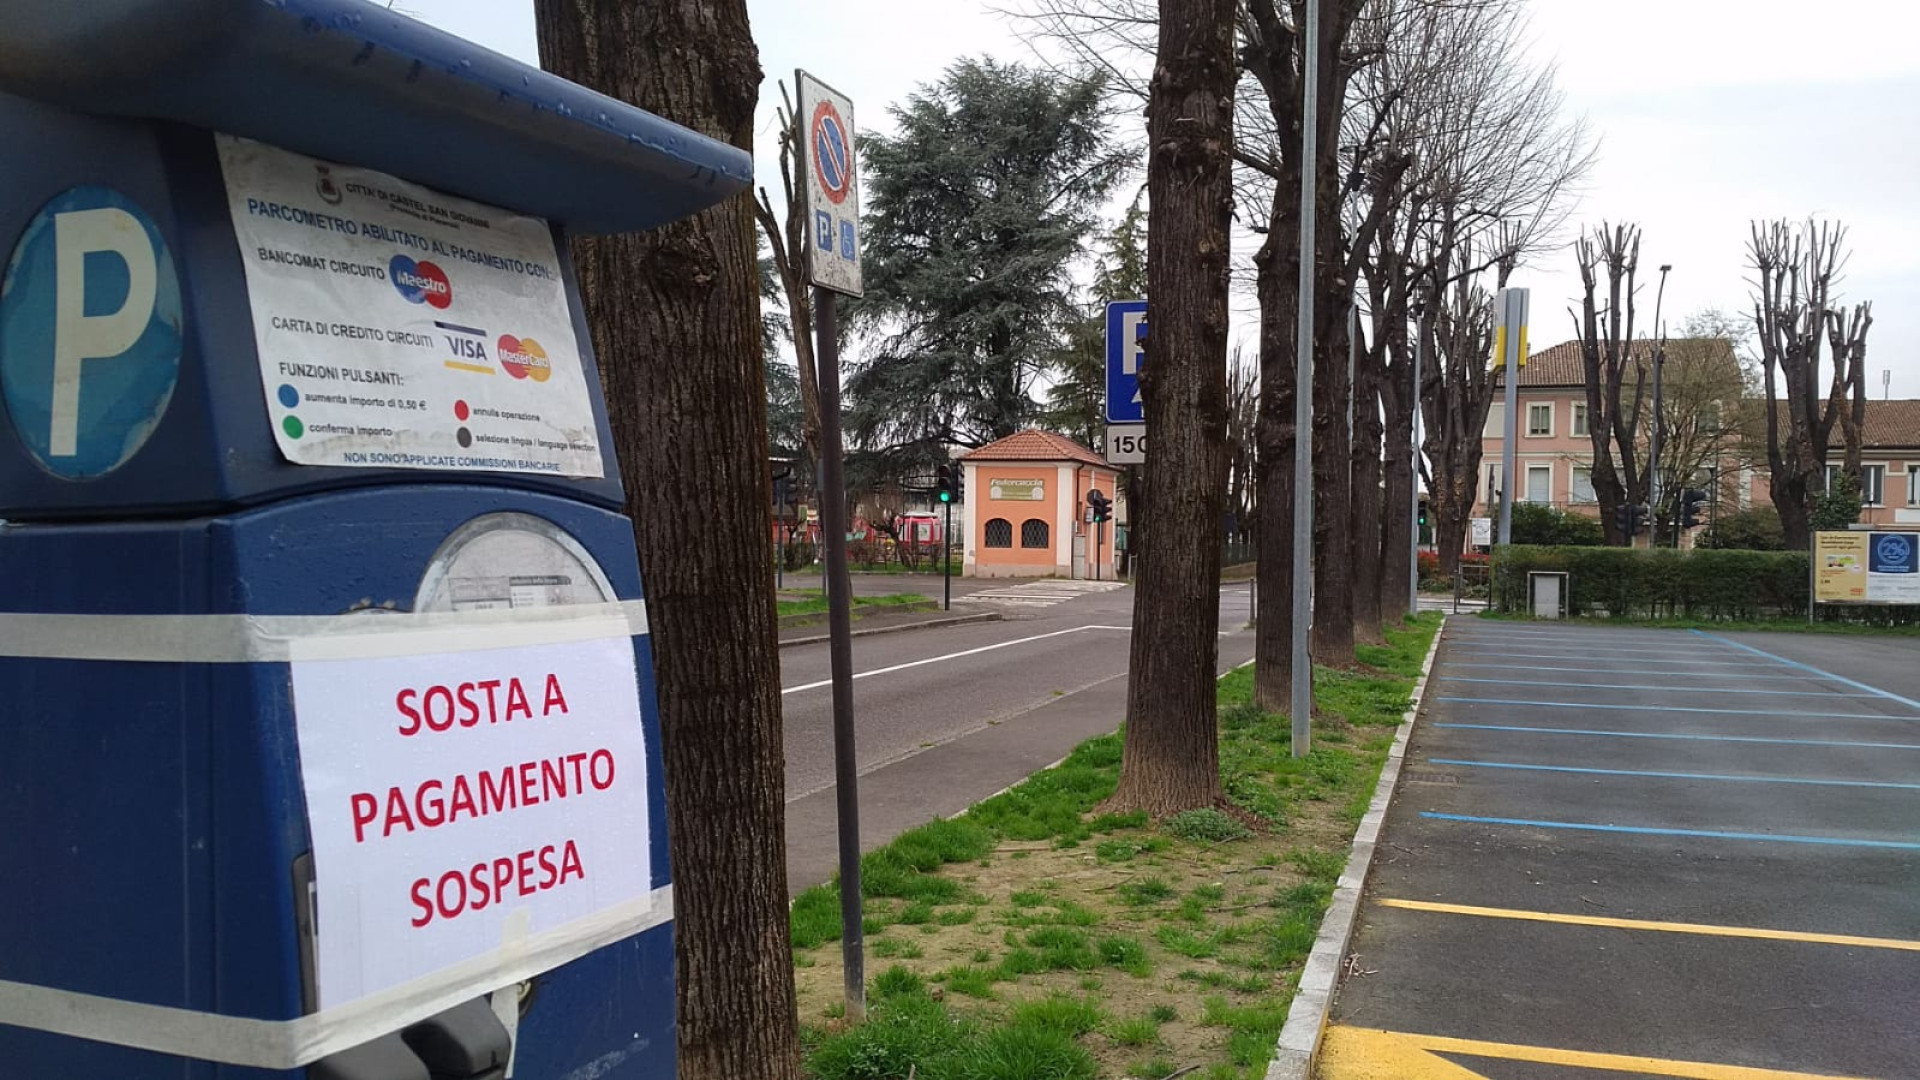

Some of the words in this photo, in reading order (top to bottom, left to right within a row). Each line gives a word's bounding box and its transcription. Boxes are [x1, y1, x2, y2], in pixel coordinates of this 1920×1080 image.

[390, 192, 426, 212] CASTEL
[428, 204, 448, 218] SAN
[247, 198, 357, 235] PARCOMETRO
[361, 222, 429, 251] ABILITATO
[432, 241, 449, 257] AL
[451, 246, 524, 273] PAGAMENTO
[819, 217, 829, 246] P
[258, 248, 326, 270] BANCOMAT
[330, 260, 385, 280] CIRCUITO
[396, 271, 447, 294] Maestro
[49, 207, 157, 456] P
[271, 316, 313, 334] CARTA
[316, 322, 329, 335] DI
[331, 324, 384, 341] CREDITO
[387, 330, 434, 348] CIRCUITI
[444, 335, 487, 361] VISA
[500, 348, 549, 368] MasterCard
[279, 362, 339, 380] FUNZIONI
[342, 368, 404, 387] PULSANTI:
[304, 393, 347, 405] aumenta
[350, 395, 385, 408] importo
[387, 398, 396, 408] di
[419, 400, 427, 411] €
[473, 407, 499, 418] annulla
[501, 410, 540, 423] operazione
[309, 423, 354, 436] conferma
[357, 425, 393, 438] importo
[476, 434, 509, 445] selezione
[511, 436, 533, 448] lingua
[538, 438, 568, 451] language
[344, 452, 366, 463] NON
[371, 452, 401, 464] SONO
[401, 453, 455, 467] APPLICATE
[458, 456, 516, 469] COMMISSIONI
[518, 460, 560, 472] BANCARIE
[395, 677, 532, 737] SOSTA
[543, 673, 568, 716] A
[351, 748, 615, 843] PAGAMENTO
[410, 840, 585, 928] SOSPESA
